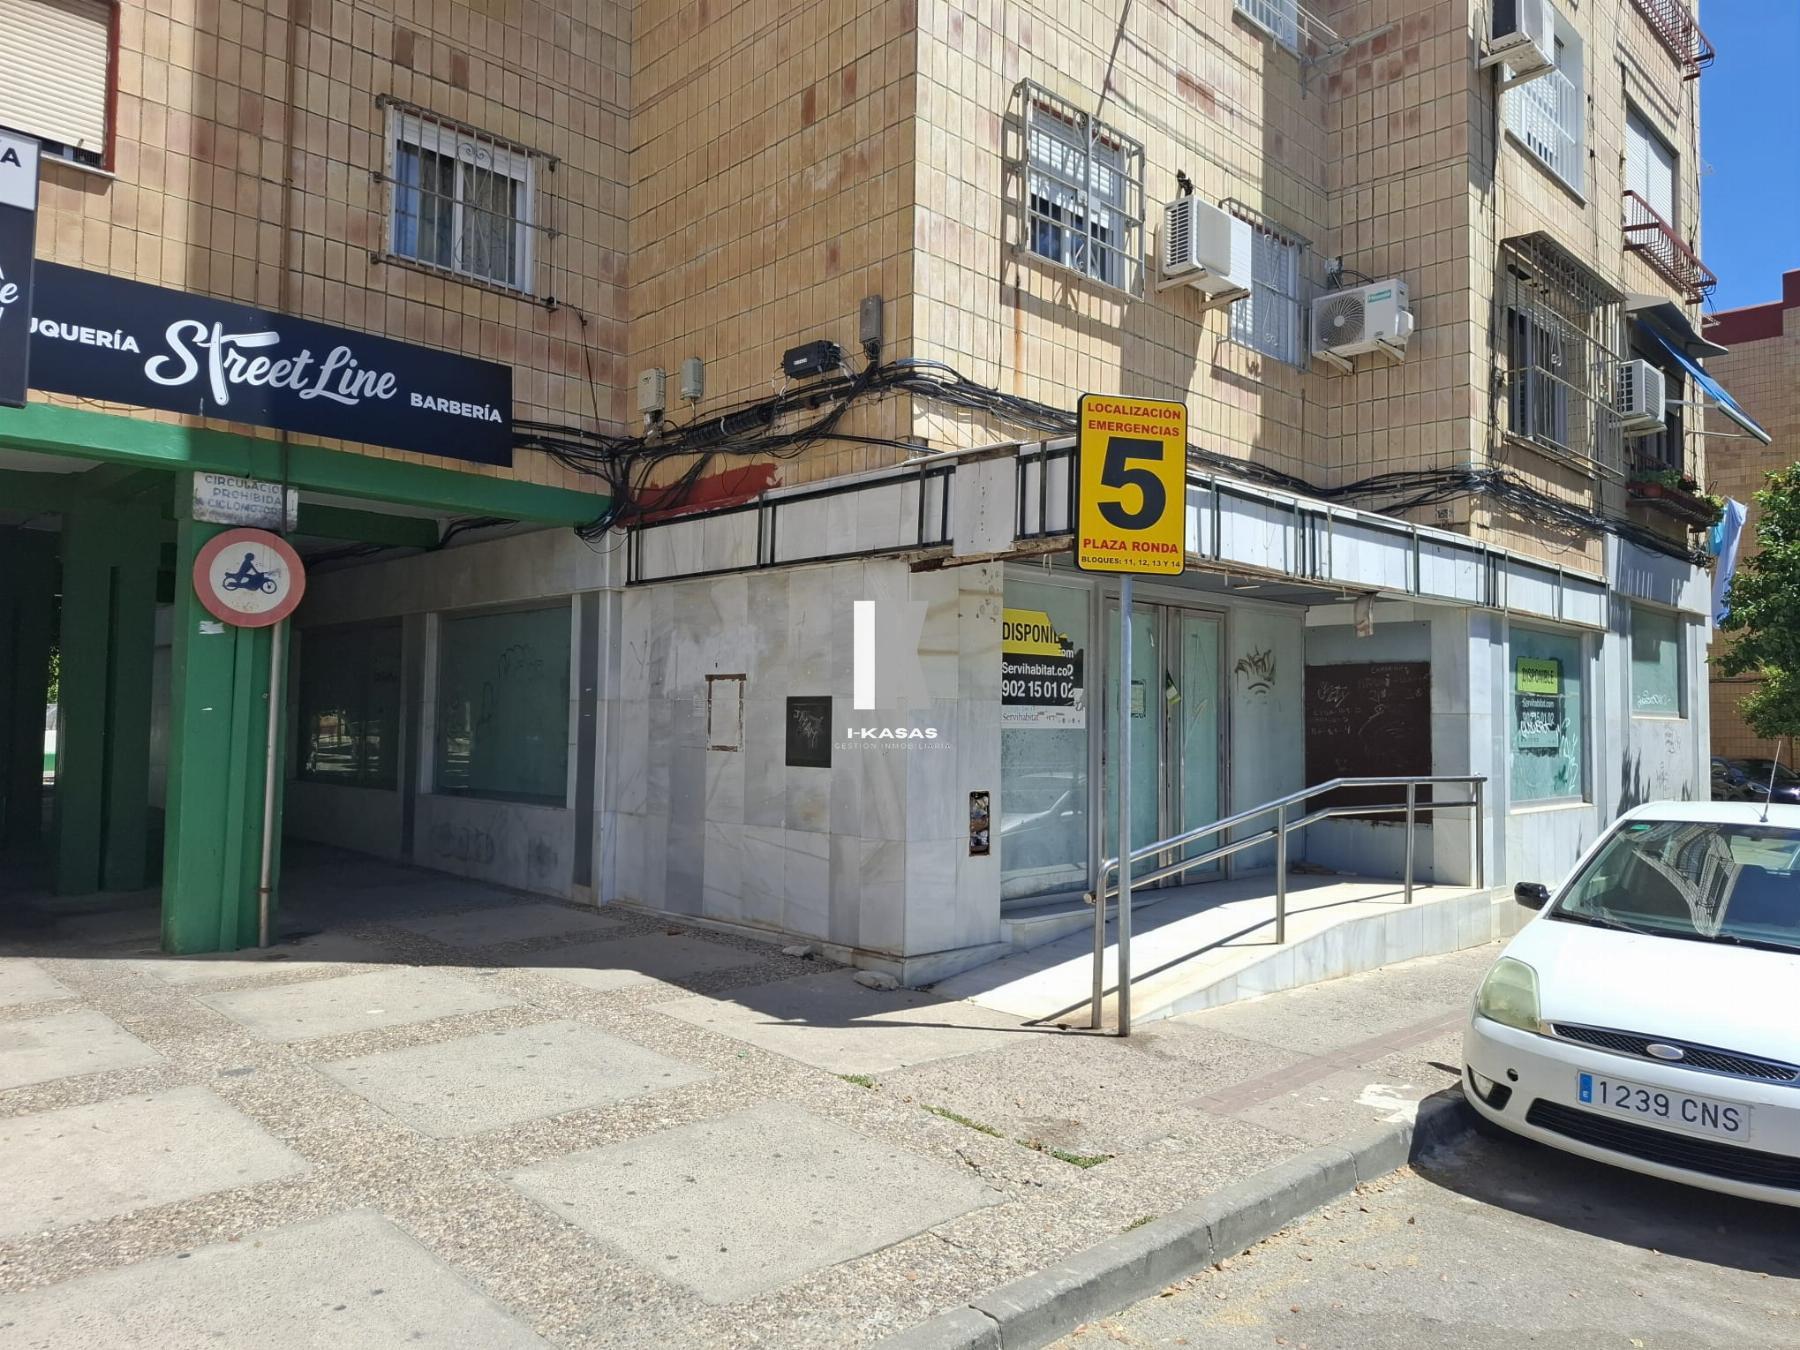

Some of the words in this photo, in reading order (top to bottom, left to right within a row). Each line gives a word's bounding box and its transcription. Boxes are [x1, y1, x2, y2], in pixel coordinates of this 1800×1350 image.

[410, 392, 502, 424] BARBERÍA
[1088, 402, 1181, 420] LOCALIZACIÓN
[1088, 420, 1180, 437] EMERGENCIAS
[204, 474, 282, 495] CIRCULACIO
[1097, 436, 1167, 531] 5
[213, 487, 282, 505] PROHIBIDA
[1083, 538, 1128, 551] PLAZA
[1132, 541, 1178, 554] RONDA
[1081, 555, 1122, 565] BLOQUES:
[1124, 558, 1136, 567] 11,
[1139, 559, 1150, 568] 12,
[1002, 680, 1026, 697] 902
[1028, 681, 1042, 698] 15
[1044, 682, 1057, 698] 01
[1600, 1081, 1669, 1118] 1239
[1681, 1098, 1739, 1132] CNS
